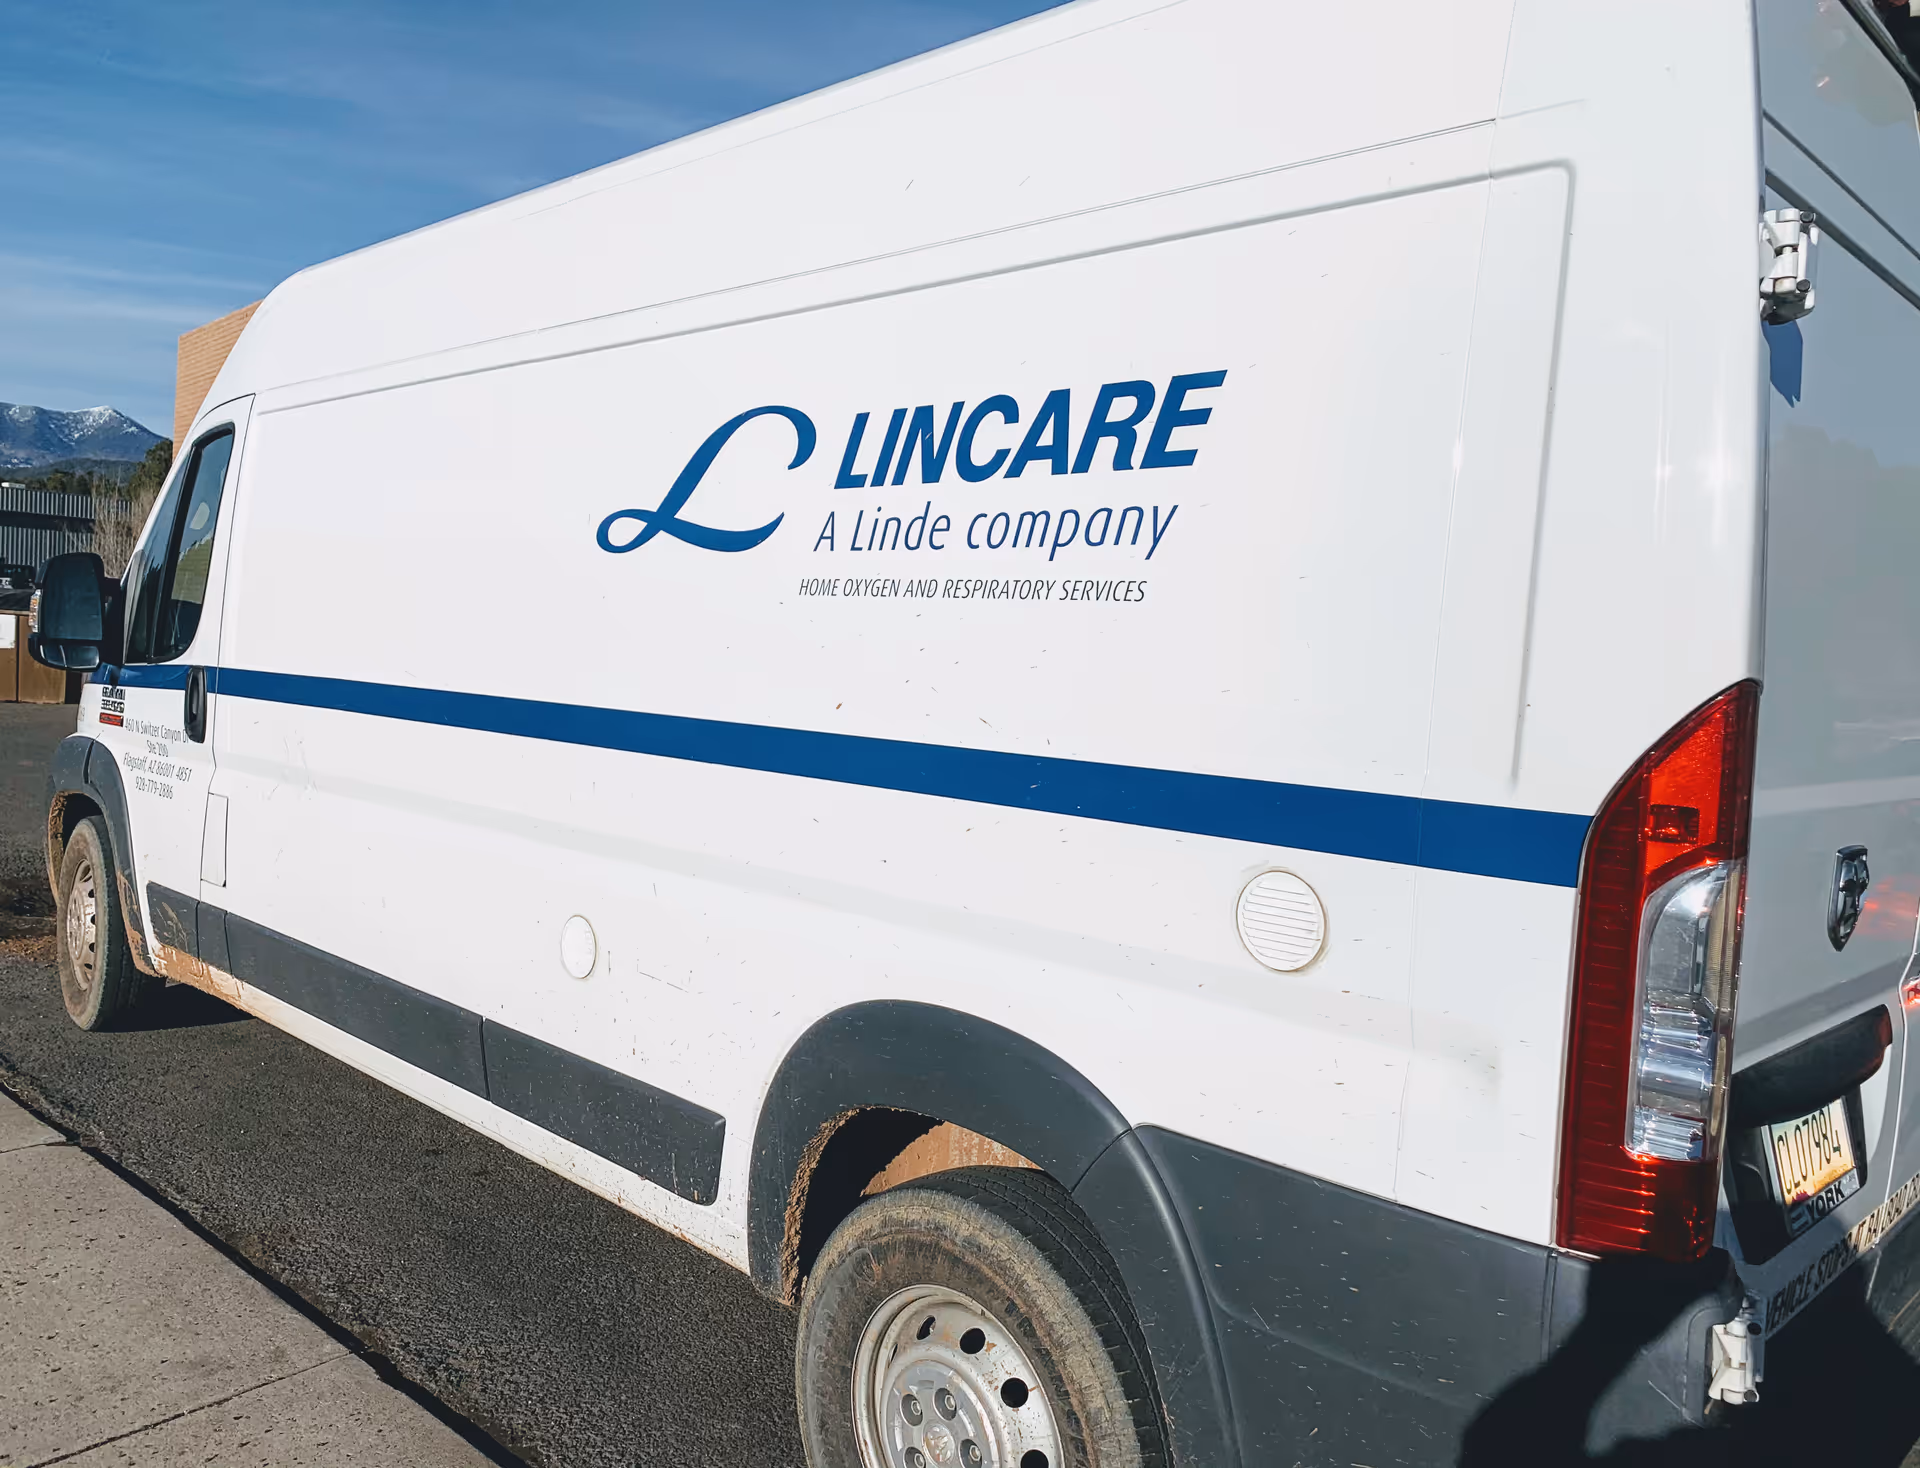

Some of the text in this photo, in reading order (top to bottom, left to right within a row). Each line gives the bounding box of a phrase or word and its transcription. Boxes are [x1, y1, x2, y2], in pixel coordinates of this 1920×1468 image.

[834, 370, 1227, 489] LINCARE
[813, 501, 1178, 561] A Linde company
[799, 578, 1147, 602] HOME OXYGEN AND RESPIRATORY SERVICES
[125, 718, 135, 732] 460
[140, 720, 160, 738] Switzer
[160, 724, 181, 744] Canyon
[146, 740, 169, 757] Ste 200
[123, 752, 192, 782] Flagstaff, AZ 86001 4851
[1807, 1180, 1845, 1222] YORK
[1765, 1263, 1815, 1338] VEHICLE
[1814, 1231, 1854, 1292] STOPS
